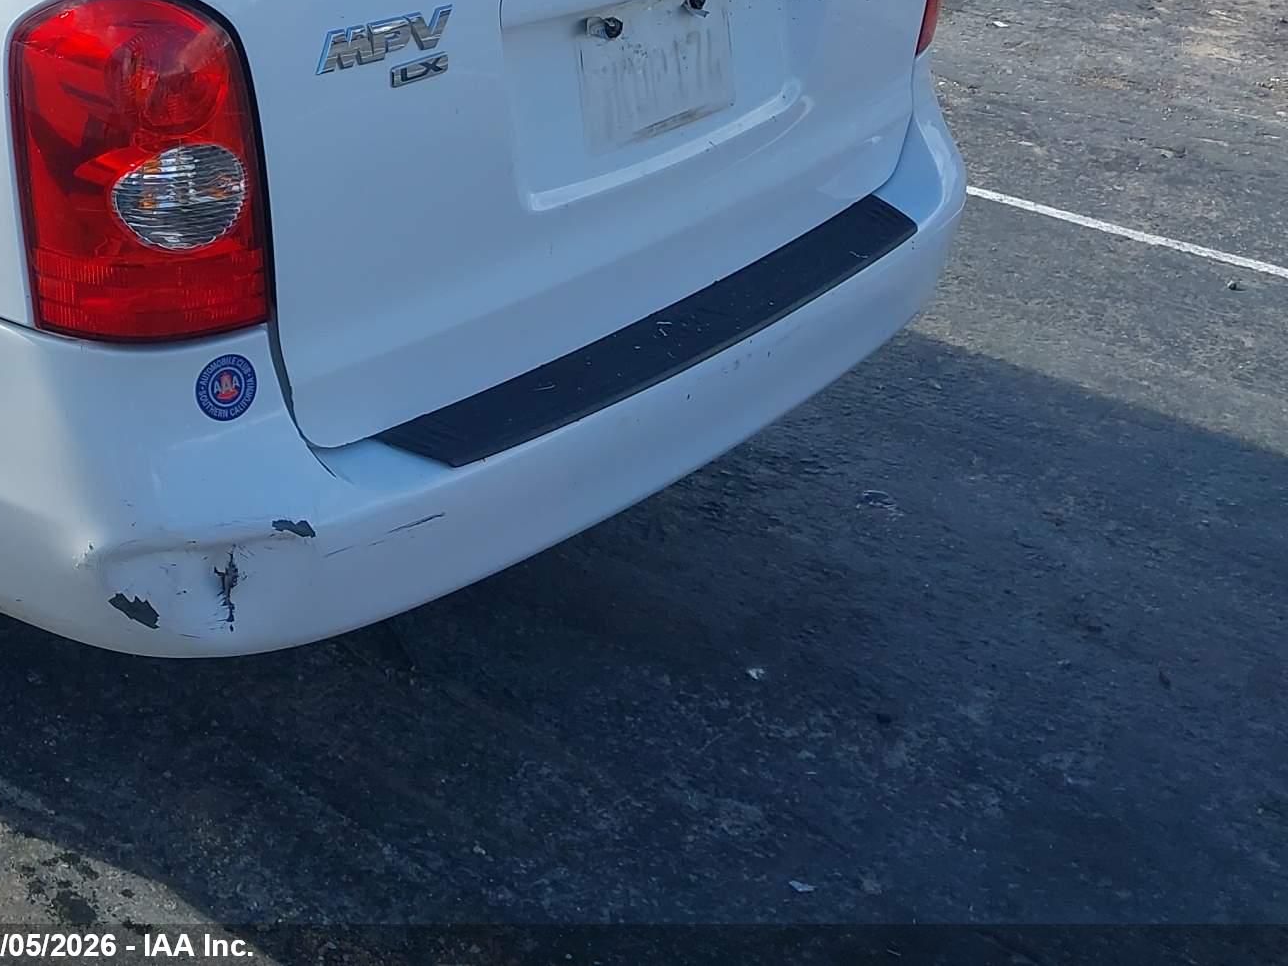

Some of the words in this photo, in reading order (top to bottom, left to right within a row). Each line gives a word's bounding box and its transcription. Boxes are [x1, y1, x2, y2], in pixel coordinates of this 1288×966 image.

[316, 4, 453, 75] MPV
[399, 54, 445, 83] LX
[199, 356, 237, 386] AUTOMOBILE
[236, 357, 252, 375] CLUB
[213, 375, 241, 394] AAA
[199, 390, 229, 418] SOUTHERN
[229, 377, 255, 417] CALIFORNIA
